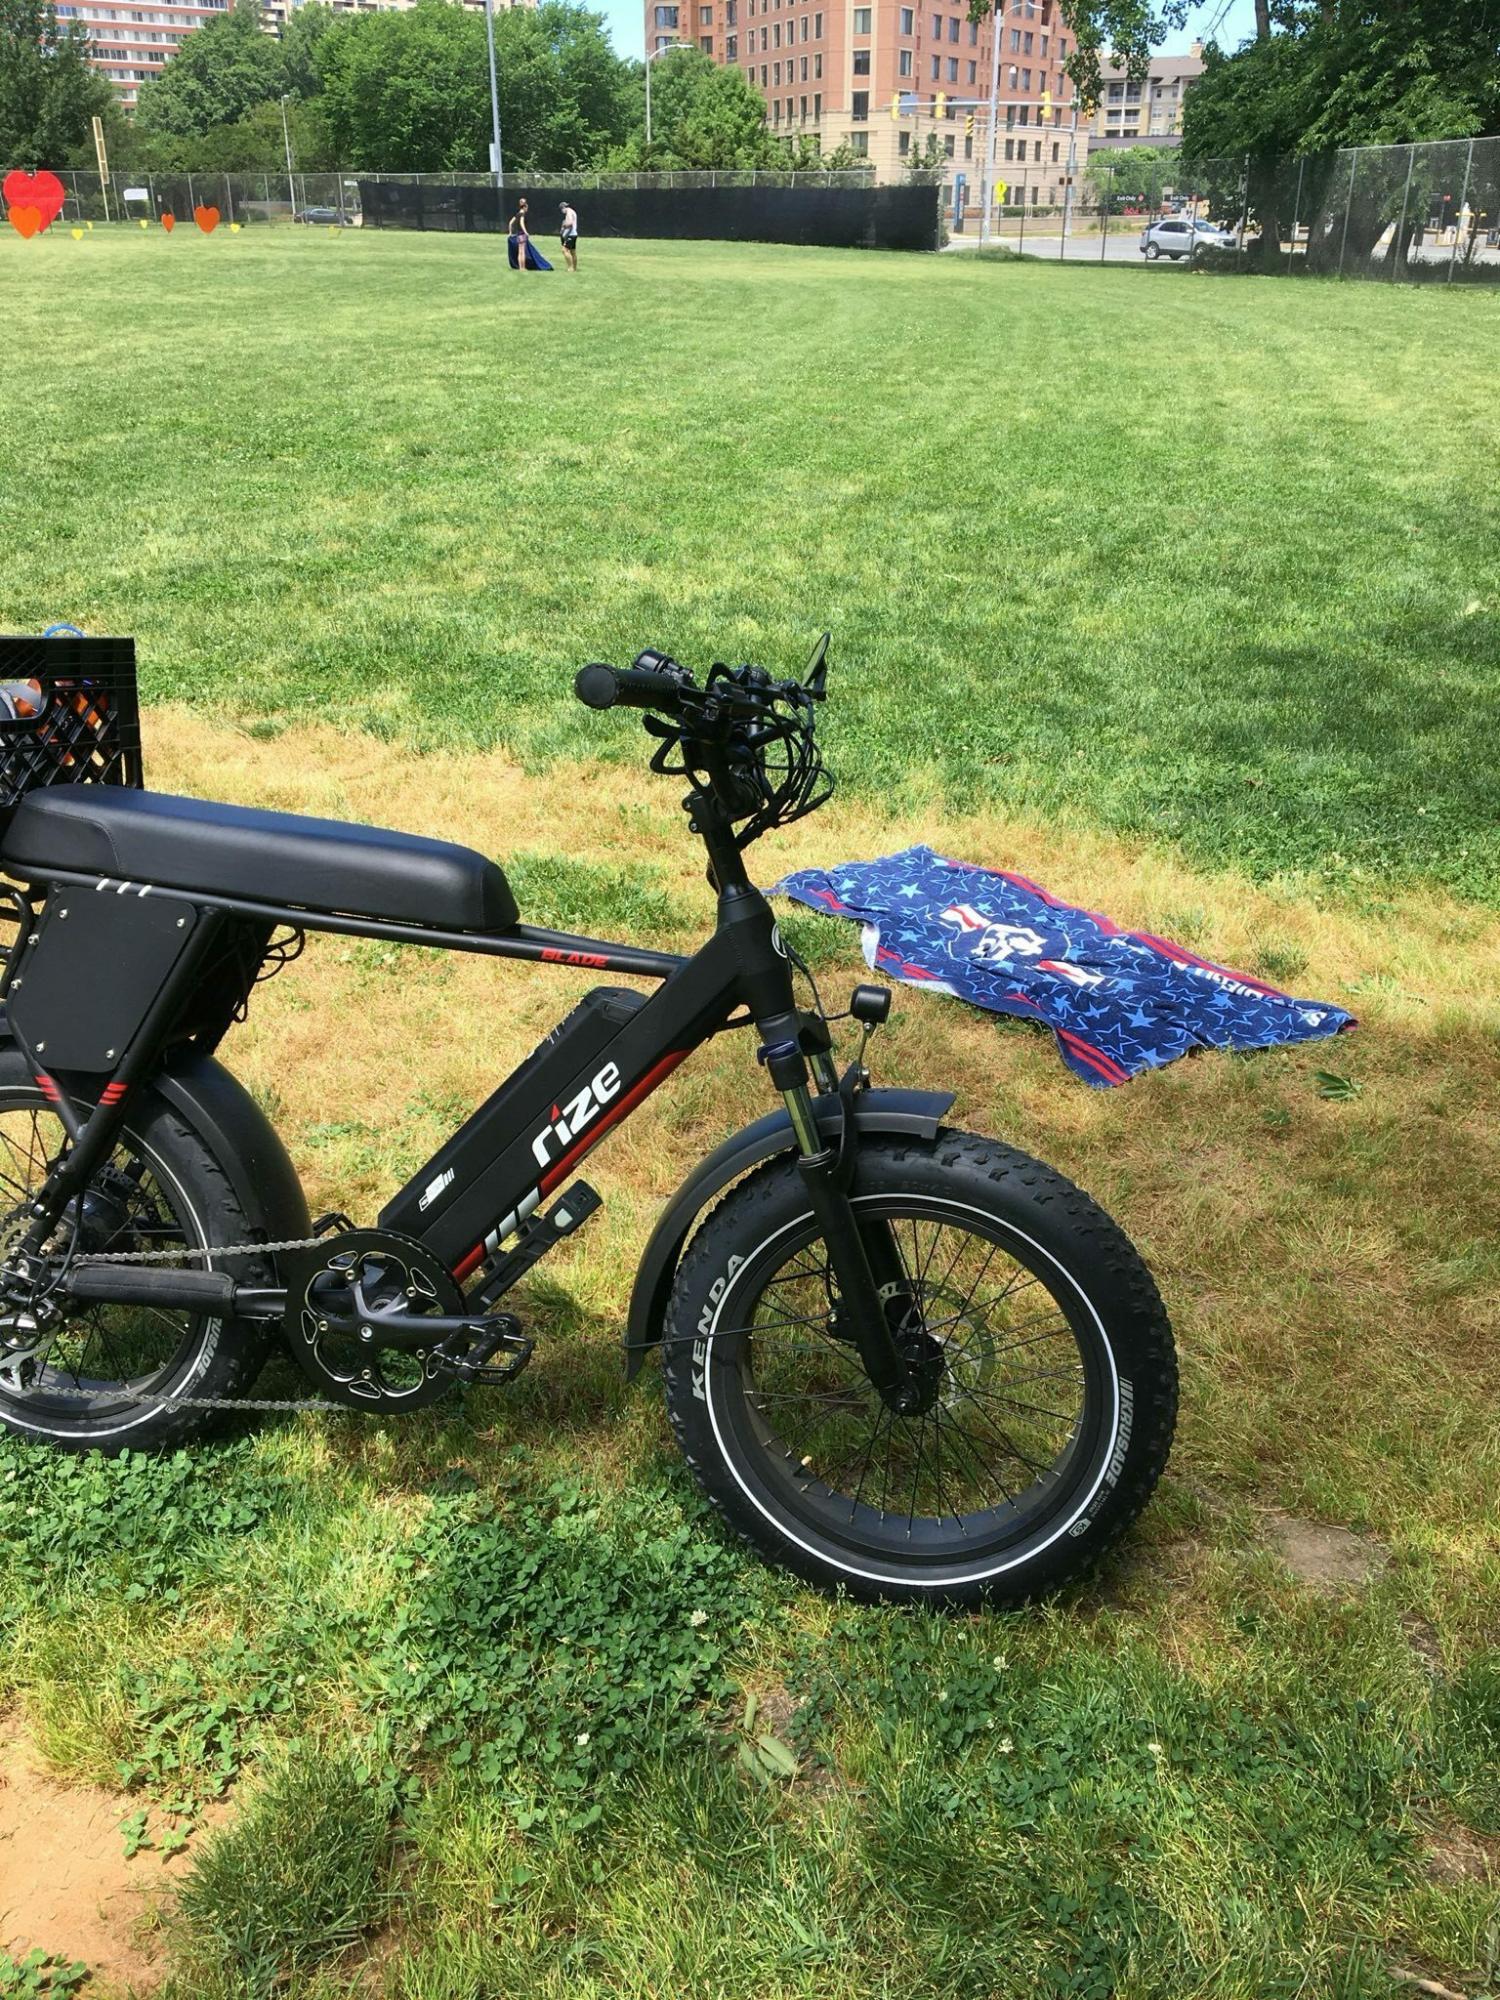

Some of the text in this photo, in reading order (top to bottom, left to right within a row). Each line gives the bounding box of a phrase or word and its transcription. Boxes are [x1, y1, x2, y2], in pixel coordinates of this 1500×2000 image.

[540, 947, 609, 967] BLADE
[531, 1061, 621, 1168] rize
[691, 1254, 745, 1401] KENDA
[1105, 1400, 1134, 1488] KRUSADE
